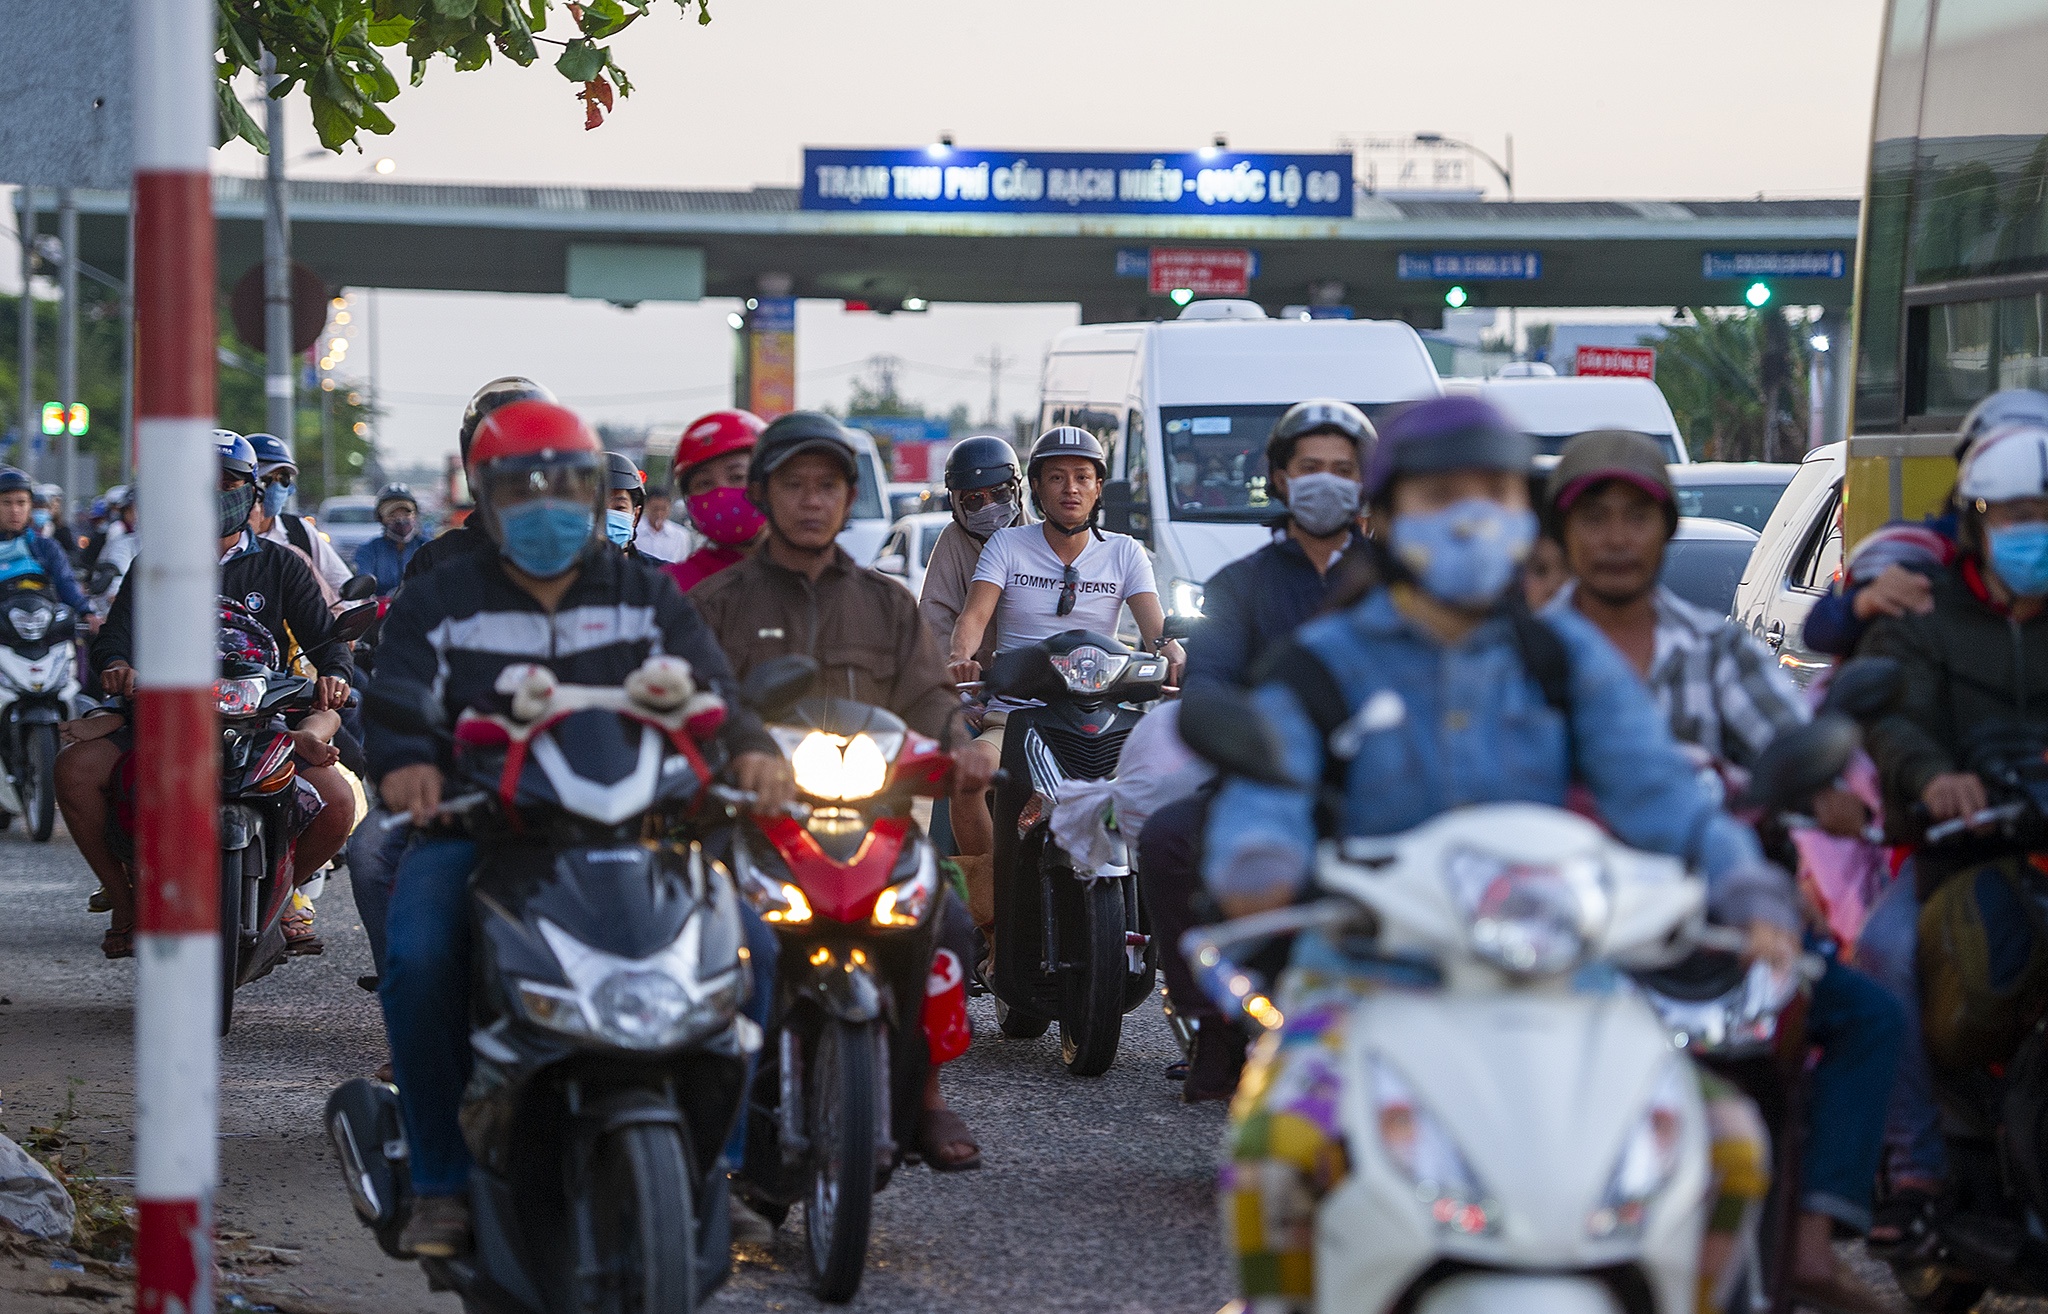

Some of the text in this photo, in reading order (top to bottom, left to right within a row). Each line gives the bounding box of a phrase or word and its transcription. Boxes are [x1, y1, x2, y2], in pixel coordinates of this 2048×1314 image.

[892, 166, 943, 200] THU
[945, 162, 990, 200] PHÍ
[1306, 171, 1341, 203] 60
[1014, 574, 1116, 594] TOMMY JEANS
